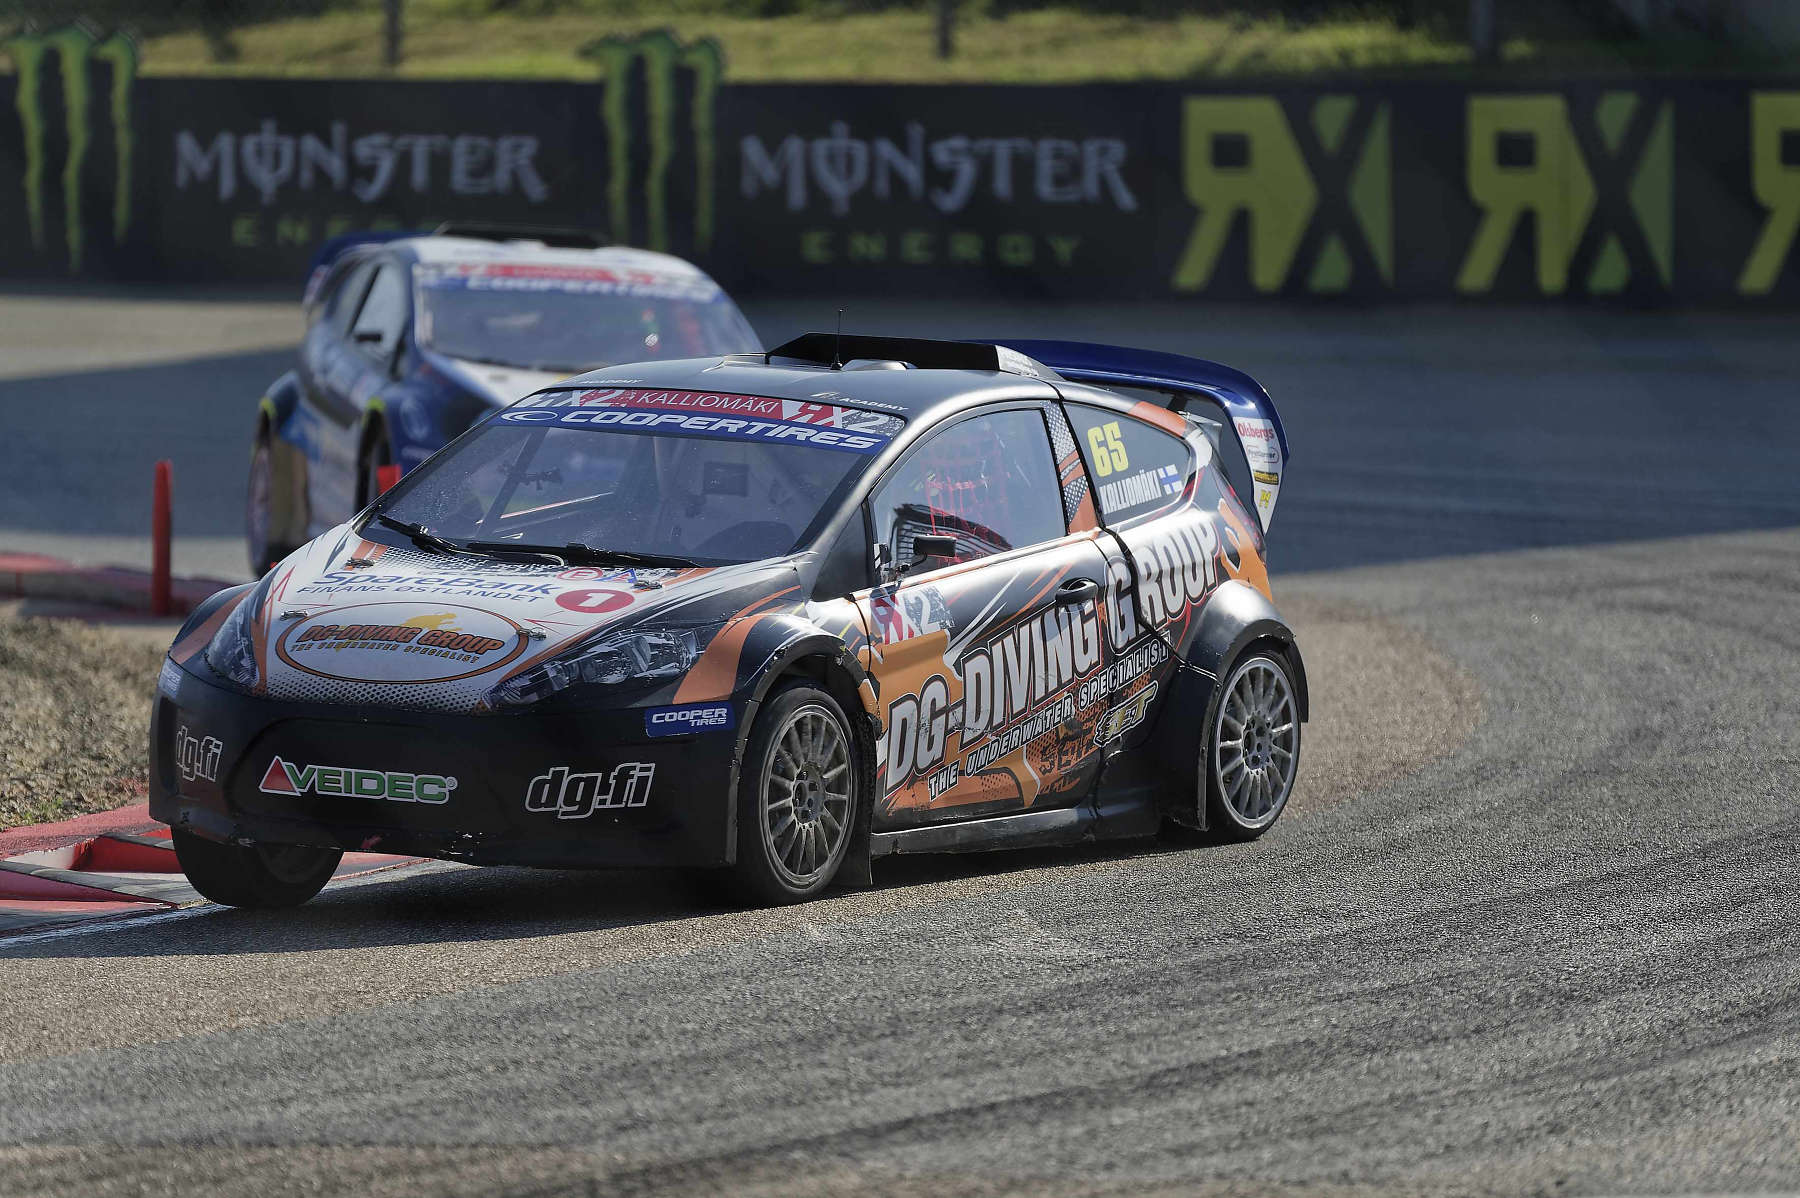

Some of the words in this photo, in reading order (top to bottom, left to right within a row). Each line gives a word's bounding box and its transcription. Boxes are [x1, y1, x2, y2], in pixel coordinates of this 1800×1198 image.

[174, 118, 548, 203] MONSTER
[741, 120, 1136, 214] MONSTER
[801, 230, 1082, 265] ENERGY
[637, 391, 780, 414] KALLIOMÄKI
[839, 397, 909, 411] ACADEMY
[1237, 423, 1275, 441] Olsbergs
[1087, 421, 1129, 477] 65
[1100, 469, 1163, 515] KALLIOMÄKI
[297, 585, 390, 593] FINANS
[395, 585, 545, 604] ØSTLANDET
[313, 571, 561, 596] SpareBank
[296, 624, 422, 644] DG-DIVING
[417, 629, 505, 655] GROUP
[884, 597, 1100, 798] DG-DIVING
[1104, 522, 1221, 654] GROUP
[652, 708, 728, 723] COOPER
[689, 717, 727, 727] TIRES
[928, 760, 961, 800] THE
[965, 693, 1075, 778] UNDERWATER
[1079, 630, 1170, 711] SPECIALIST
[525, 762, 656, 819] dg.fi
